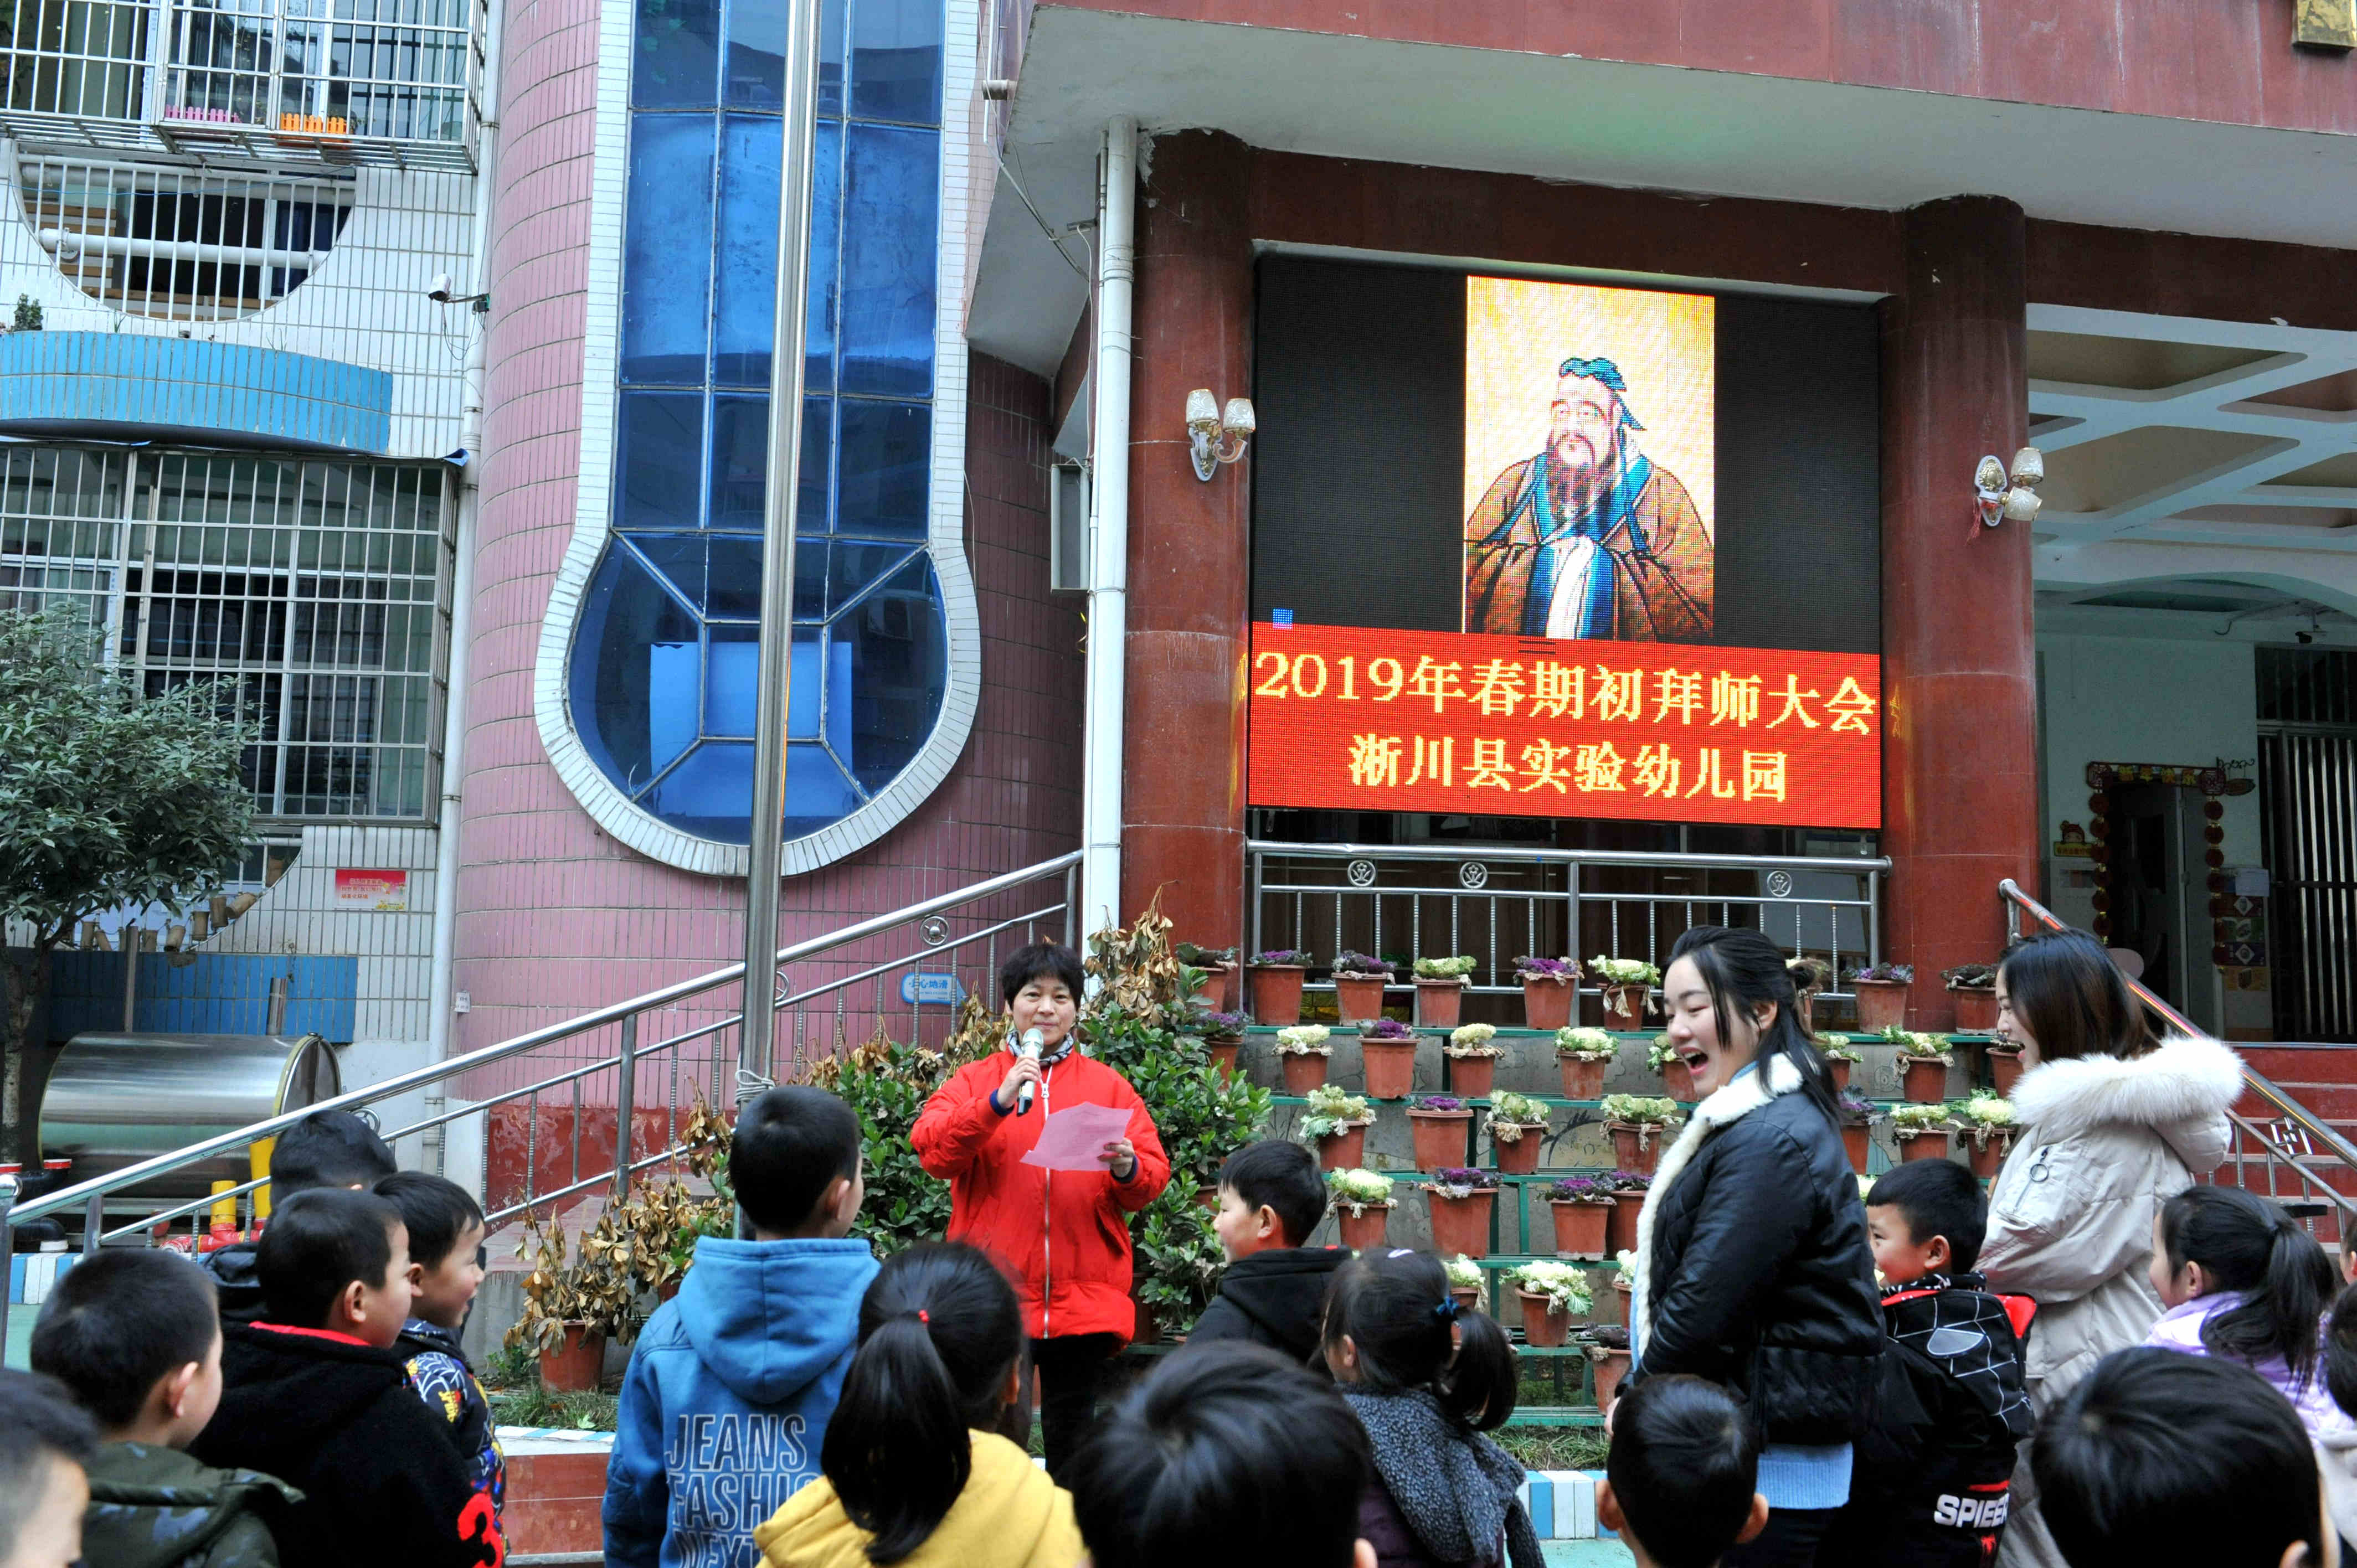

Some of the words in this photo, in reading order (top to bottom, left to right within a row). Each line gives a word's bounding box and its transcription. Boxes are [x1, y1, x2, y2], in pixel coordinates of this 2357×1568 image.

[1255, 652, 1876, 735] 2019年春期初拜师大会
[1349, 734, 1788, 802] 淅川县实验幼儿园
[665, 1414, 807, 1472] JEANS
